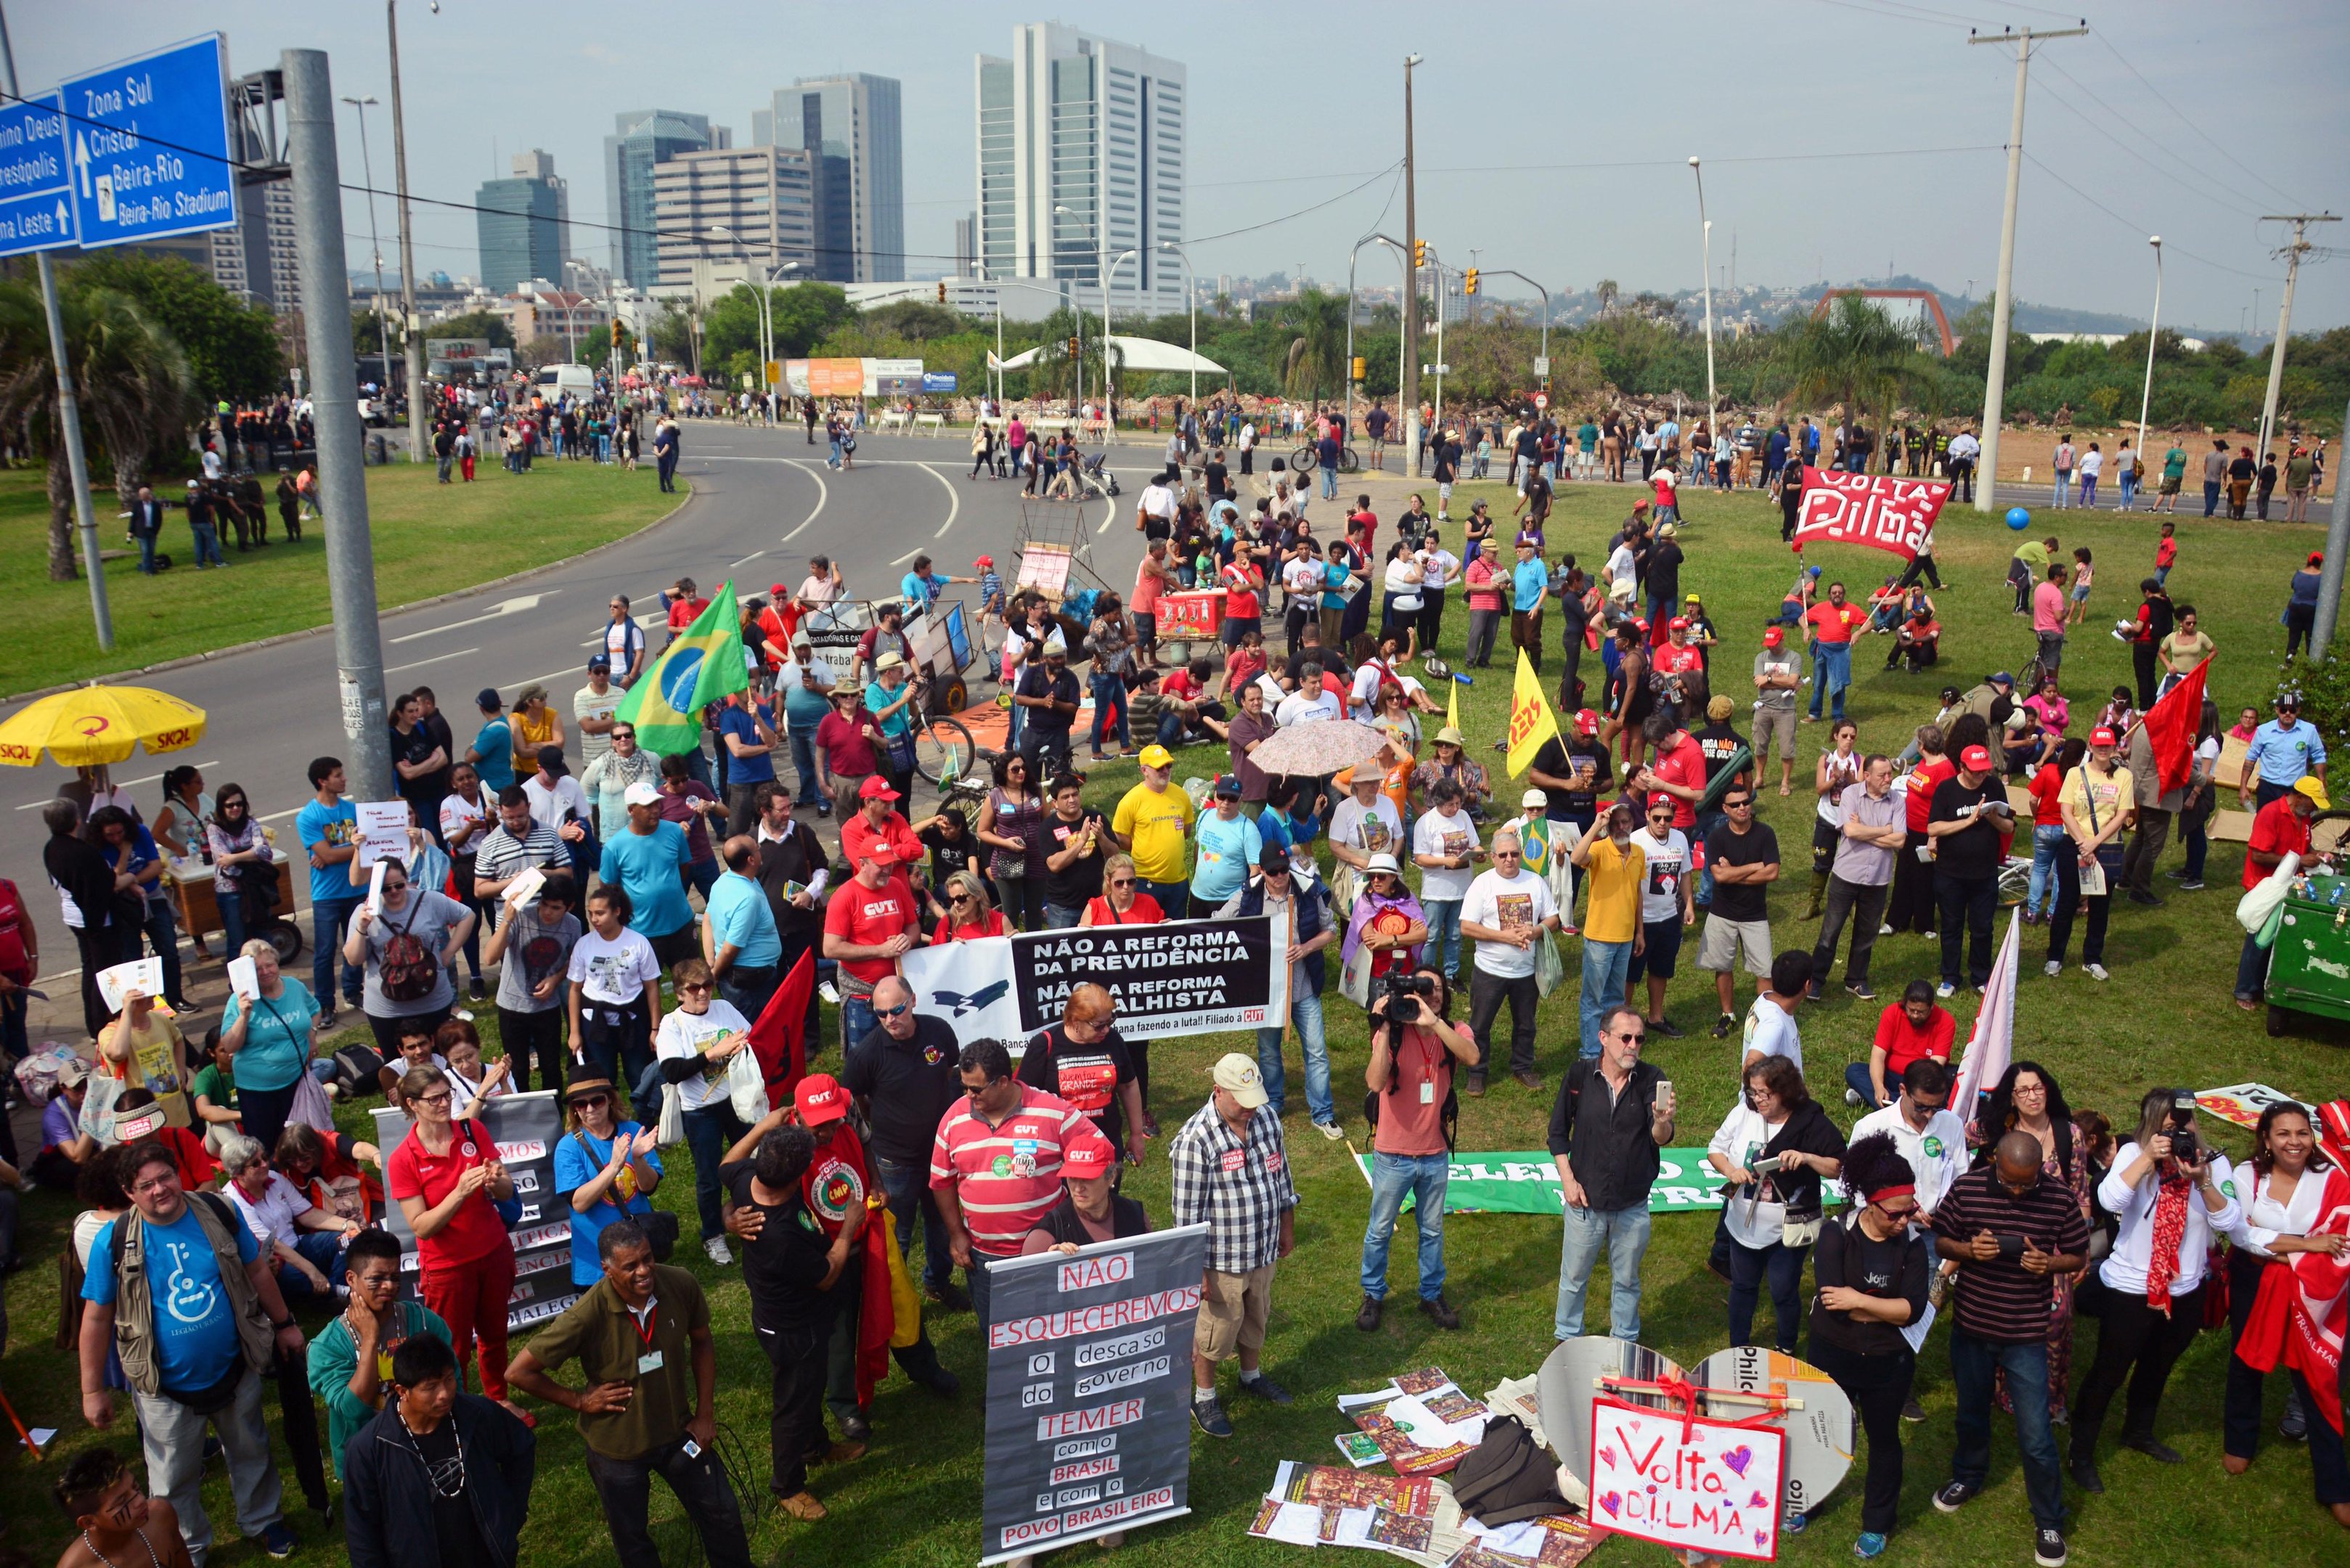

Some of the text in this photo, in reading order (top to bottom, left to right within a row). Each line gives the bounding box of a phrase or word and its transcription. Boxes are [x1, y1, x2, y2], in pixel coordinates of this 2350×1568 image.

[85, 73, 153, 118] Zona Sul
[25, 115, 61, 142] Deus
[91, 120, 139, 158] Cristal
[113, 152, 184, 191] Beira-Rio
[118, 187, 229, 226] Beira-Rio Stadium
[17, 212, 54, 237] Leste
[1820, 471, 1929, 501] VOLTA
[1795, 487, 1927, 552] Dilma
[1702, 738, 1737, 751] DIGA NÃO A
[876, 843, 892, 853] CUT
[864, 899, 894, 916] CUT
[1034, 931, 1240, 958] NÃO A REFORMA
[1035, 946, 1249, 976] DA PREVIDÊNCIA
[1109, 982, 1125, 995] A
[1129, 975, 1227, 995] REFORMA
[1038, 989, 1226, 1020] TRALHISTA
[1137, 1020, 1172, 1032] fazendo
[1181, 1015, 1204, 1028] luta!!
[1205, 1013, 1235, 1024] Filiado
[1244, 1009, 1264, 1022] CUT
[808, 1090, 831, 1104] CUT
[1060, 1079, 1098, 1092] GRANDE
[126, 1122, 150, 1132] FORA
[128, 1127, 151, 1137] TEMER
[1014, 1124, 1039, 1134] CUT
[1070, 1151, 1091, 1160] CUT
[1223, 1154, 1244, 1164] FORA
[1225, 1161, 1244, 1170] TEMER
[820, 1161, 839, 1177] FORA
[829, 1183, 848, 1201] CMP
[990, 1285, 1200, 1348] ESQUECEREMOS
[171, 1324, 198, 1336] LEGIÃO
[1024, 1385, 1051, 1404] do
[1043, 1398, 1141, 1437] TEMER
[1810, 1416, 1822, 1443] ACOMPANHA
[1053, 1457, 1116, 1482] BRASIL
[1615, 1426, 1728, 1494] Volta
[1040, 1480, 1120, 1506] e com o
[1784, 1479, 1803, 1523] hilco
[1005, 1488, 1171, 1543] POVO BRASILEIRO
[1545, 1514, 1572, 1525] rimeiro
